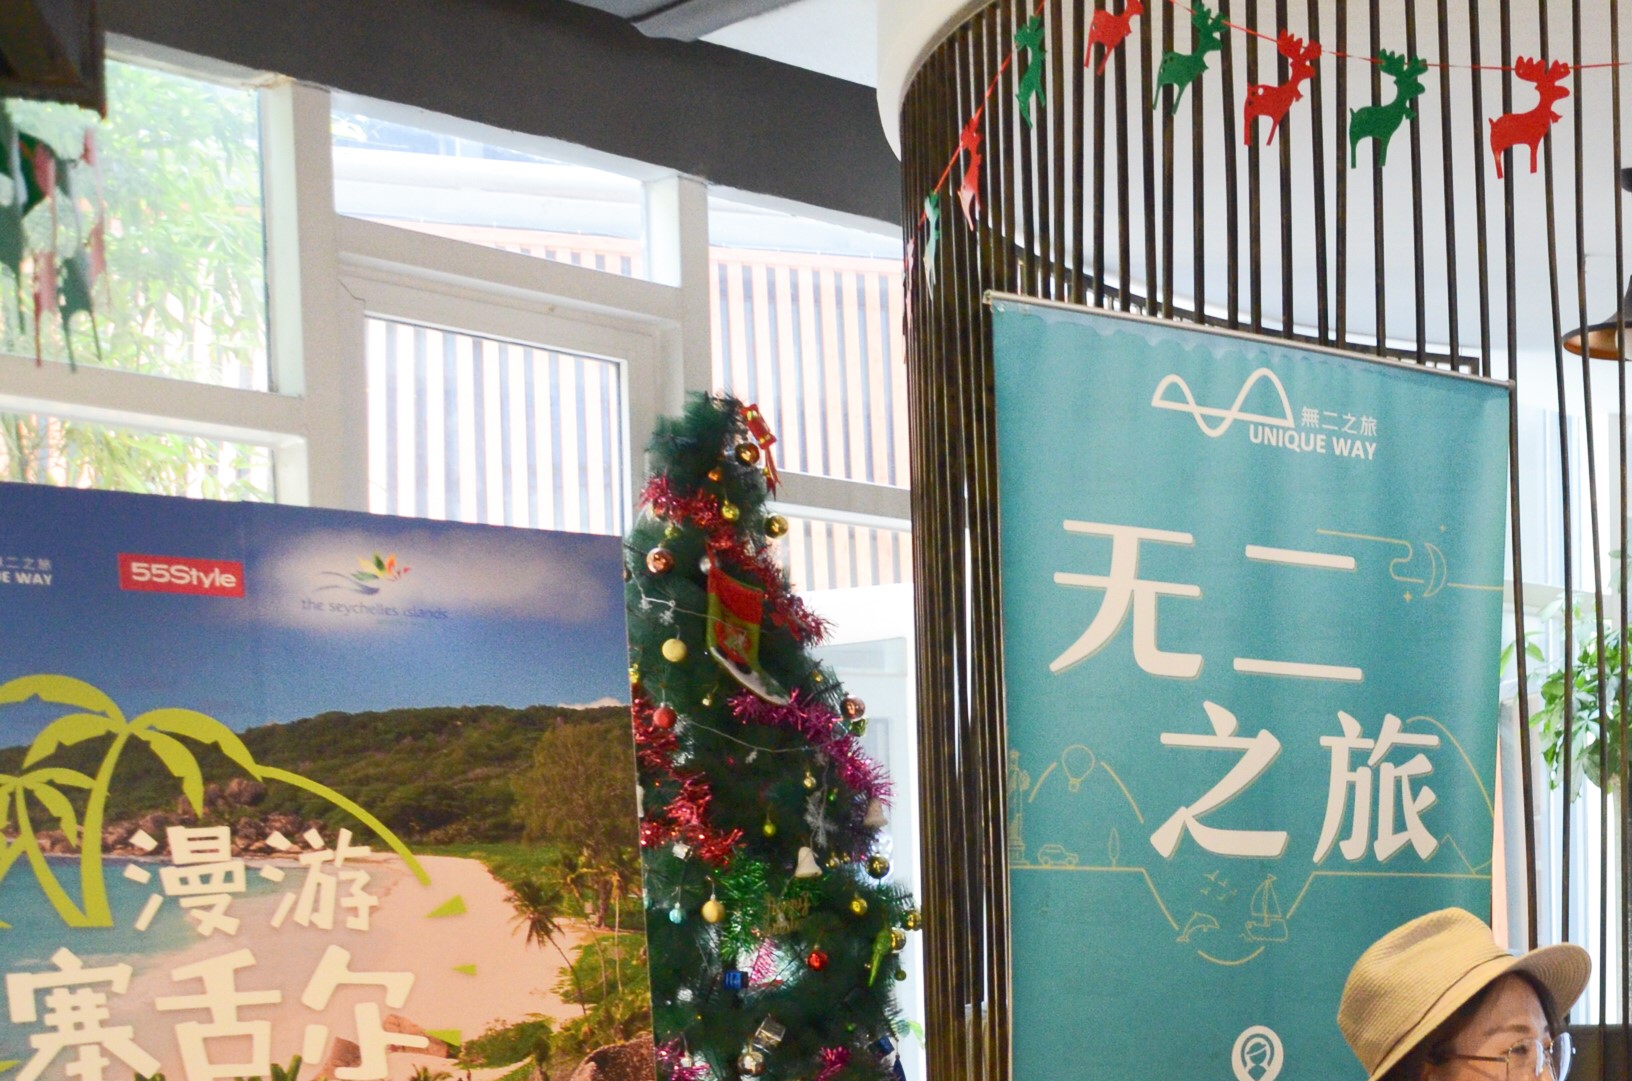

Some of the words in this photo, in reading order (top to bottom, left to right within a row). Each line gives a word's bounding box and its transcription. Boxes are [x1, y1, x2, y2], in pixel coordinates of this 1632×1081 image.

[1301, 406, 1377, 437] 無二之旅
[1249, 424, 1327, 453] UNIQUE
[1332, 436, 1377, 460] WAY
[15, 571, 53, 586] WAY
[130, 561, 237, 588] 55Style
[301, 598, 324, 612] the
[1048, 519, 1364, 682] 无二
[1150, 700, 1441, 864] 之旅
[123, 825, 379, 936] 漫游
